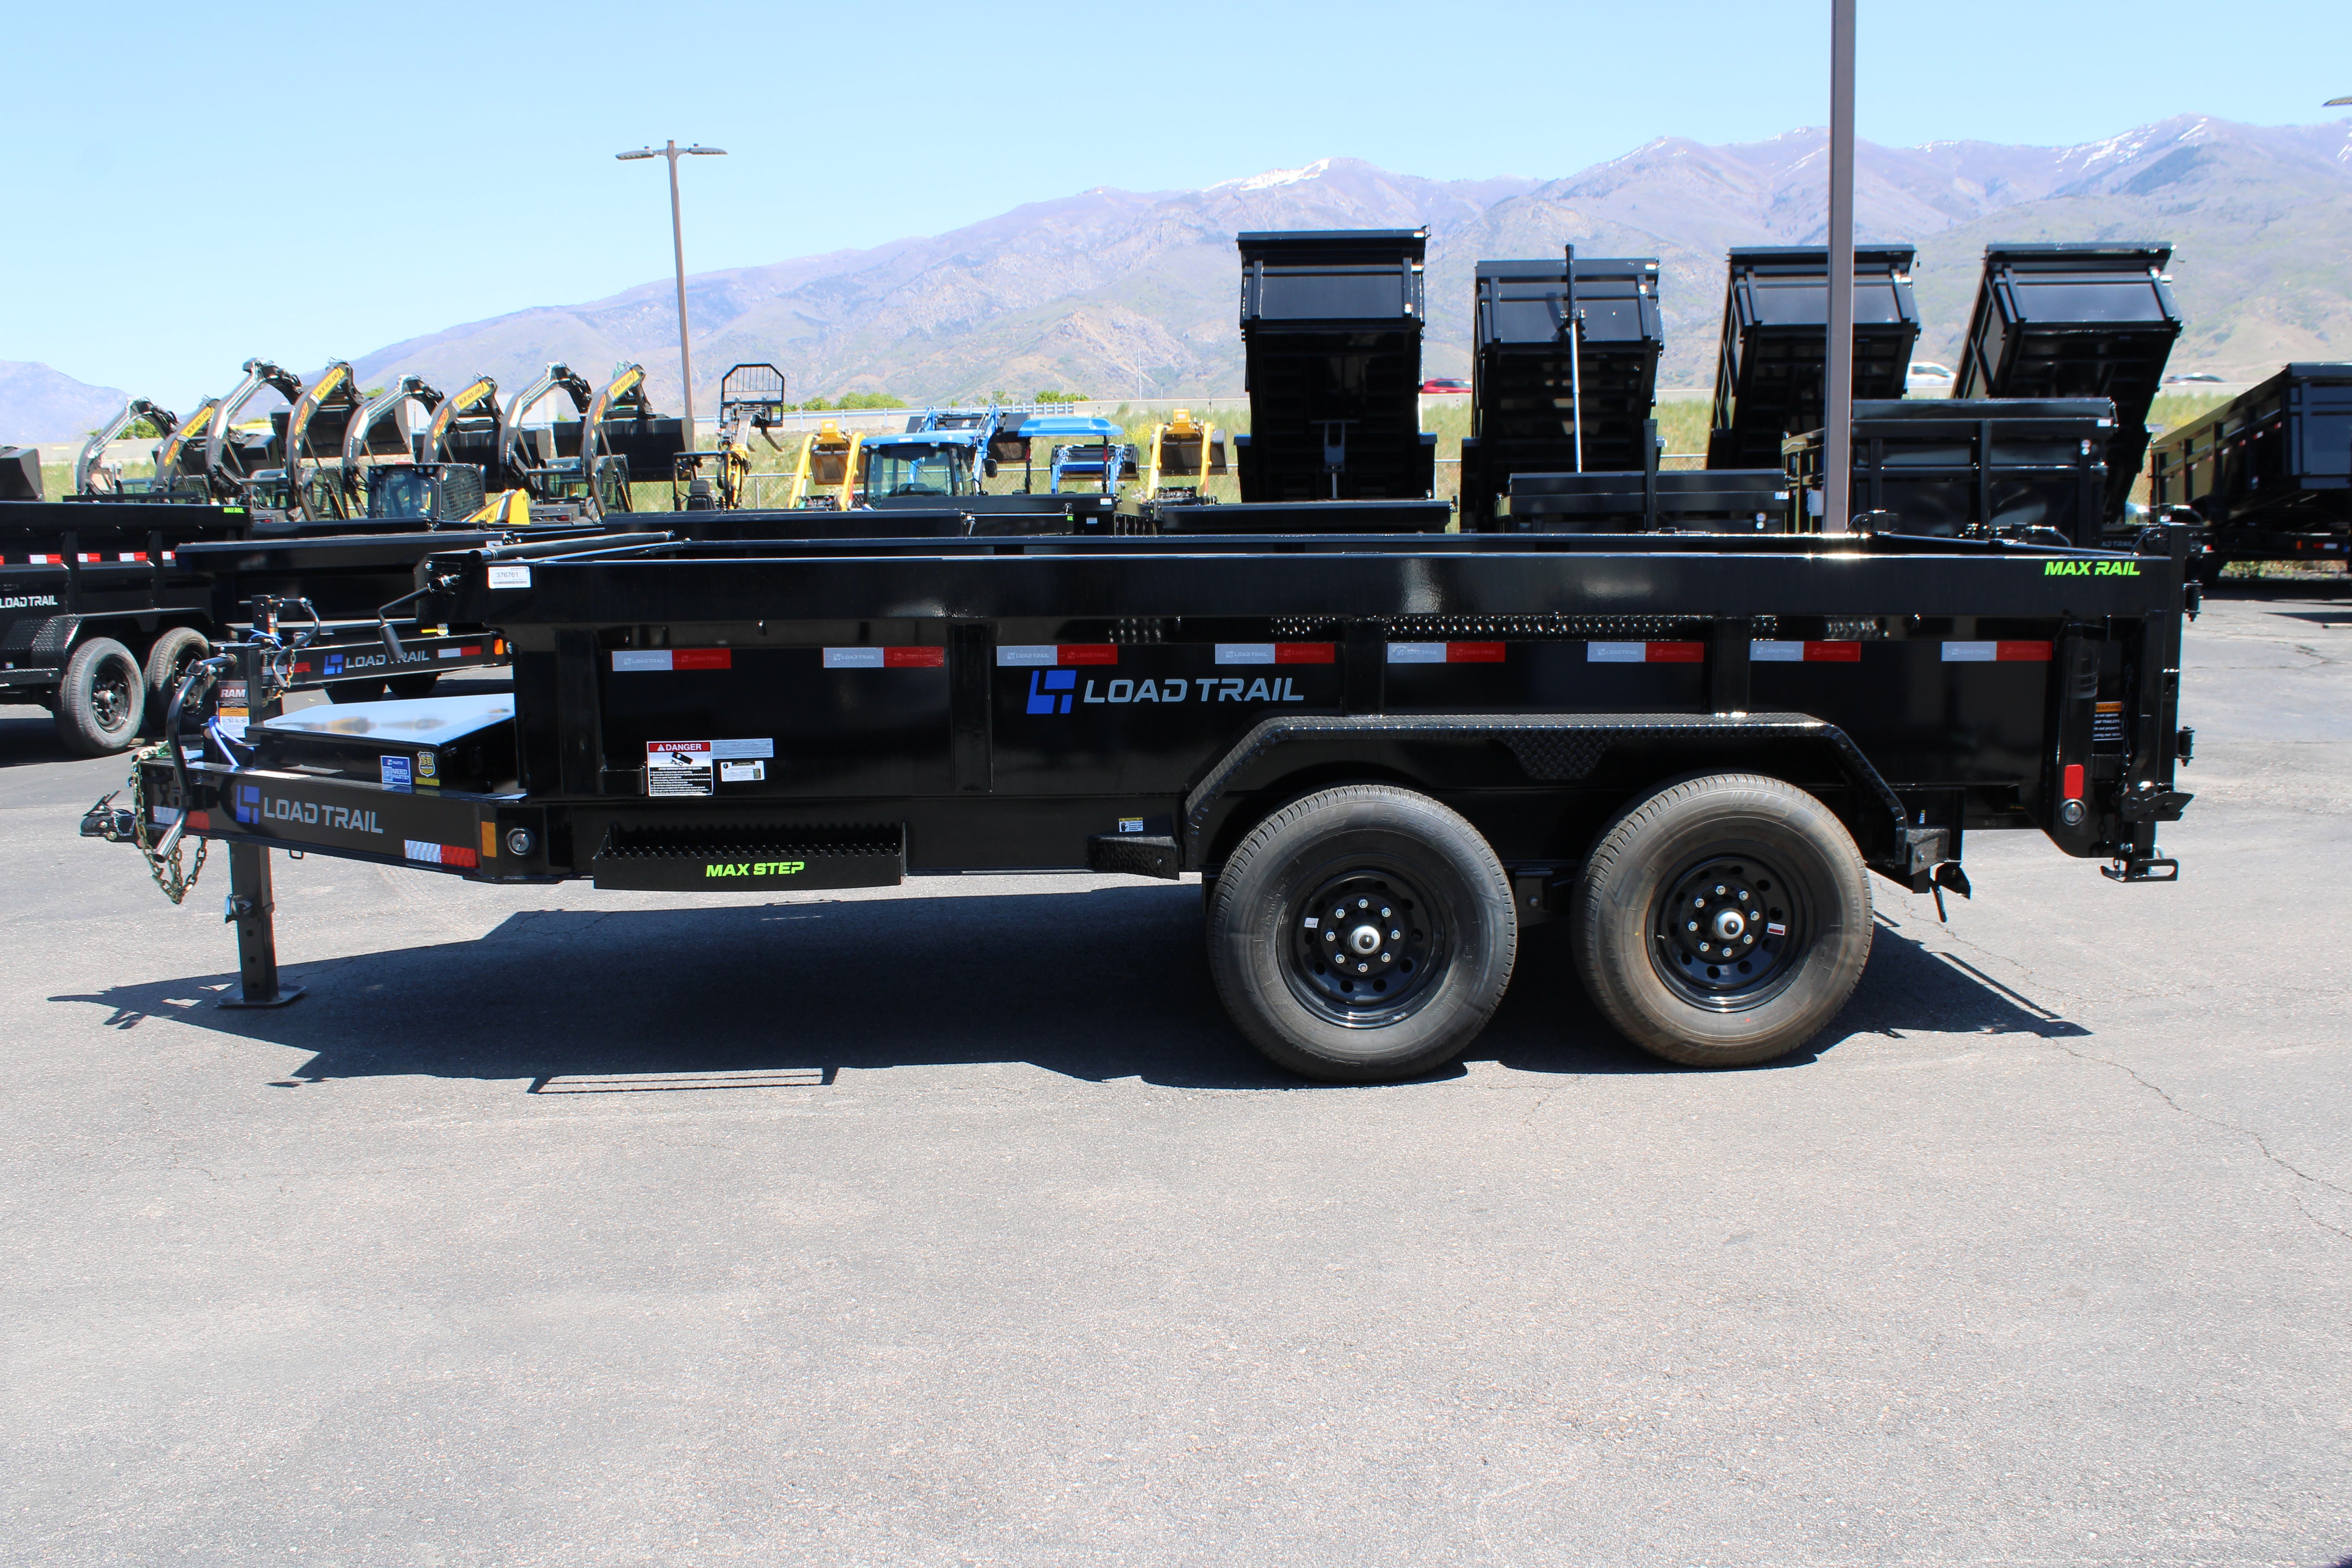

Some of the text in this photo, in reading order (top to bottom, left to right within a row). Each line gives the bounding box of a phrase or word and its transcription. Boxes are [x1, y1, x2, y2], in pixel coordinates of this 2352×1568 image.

[467, 385, 482, 399] HOLLAND
[194, 409, 211, 427] HOLLAND
[2045, 561, 2140, 576] MAX RAIL
[0, 595, 58, 609] LOAD TRAIL
[345, 650, 430, 668] LOAD RAIL
[221, 689, 246, 698] RAM
[1084, 678, 1304, 703] LOAD TRAIL
[263, 797, 384, 834] LOAD TRAIL
[706, 861, 805, 877] MAX STEP
